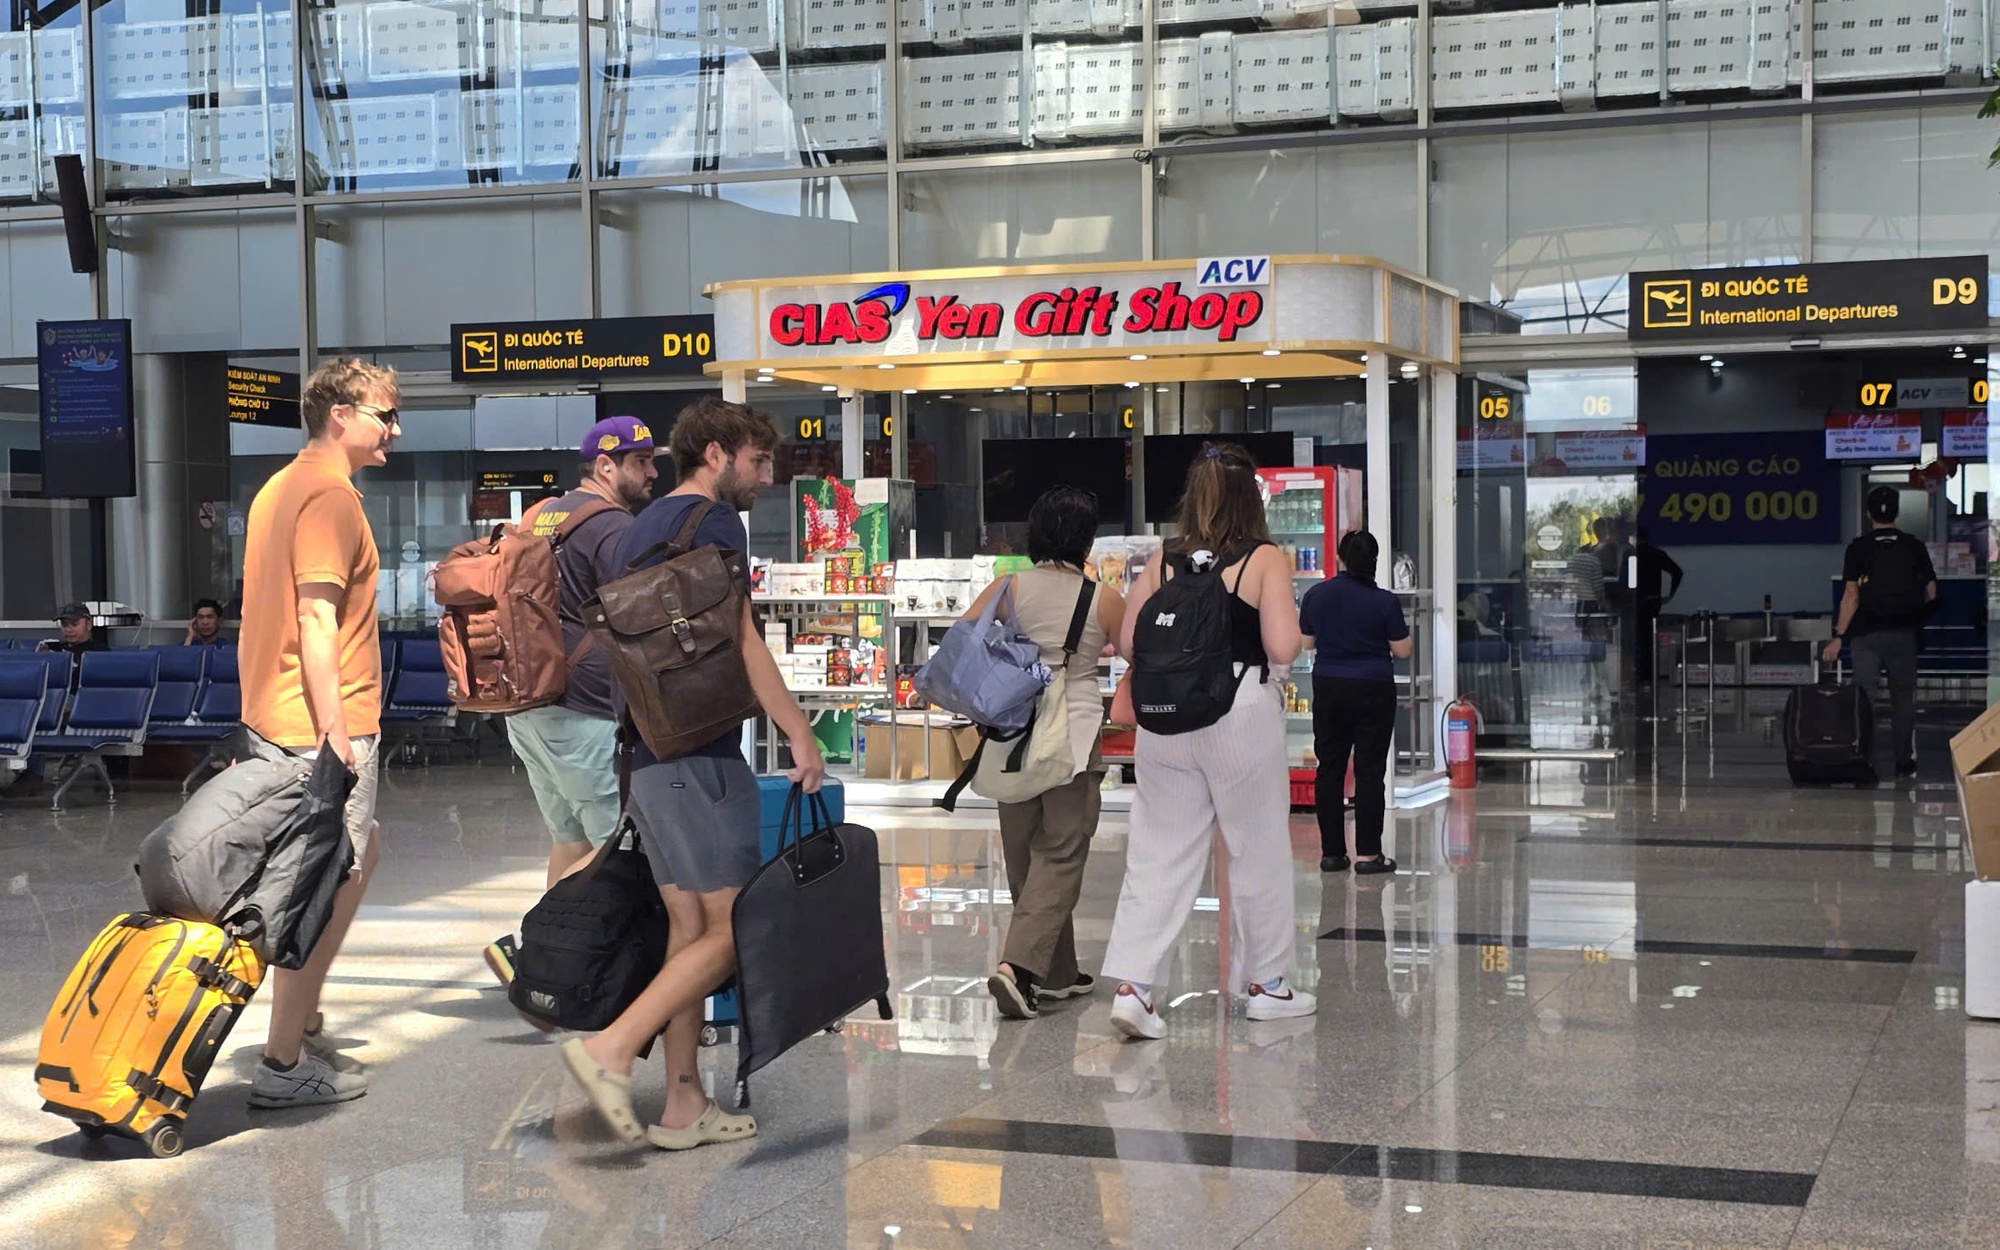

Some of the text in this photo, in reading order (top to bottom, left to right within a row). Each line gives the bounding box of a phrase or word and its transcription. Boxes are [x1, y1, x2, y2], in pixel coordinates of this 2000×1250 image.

[1199, 258, 1267, 285] ACV
[1932, 277, 1978, 305] D9
[769, 282, 1264, 345] CIAS Yen Gift Shop
[1700, 303, 1898, 325] International Departures
[662, 332, 711, 358] D10
[504, 354, 650, 371] International Departures
[228, 381, 249, 393] Security
[1860, 383, 1893, 406] 07
[1900, 387, 1931, 400] ACV
[1480, 396, 1510, 419] 05
[1582, 396, 1612, 416] 06
[800, 418, 821, 438] 01
[1654, 453, 1801, 478] QUẢNG CÁO
[543, 474, 554, 483] 02
[1659, 492, 1731, 523] 490
[1745, 490, 1818, 521] 000
